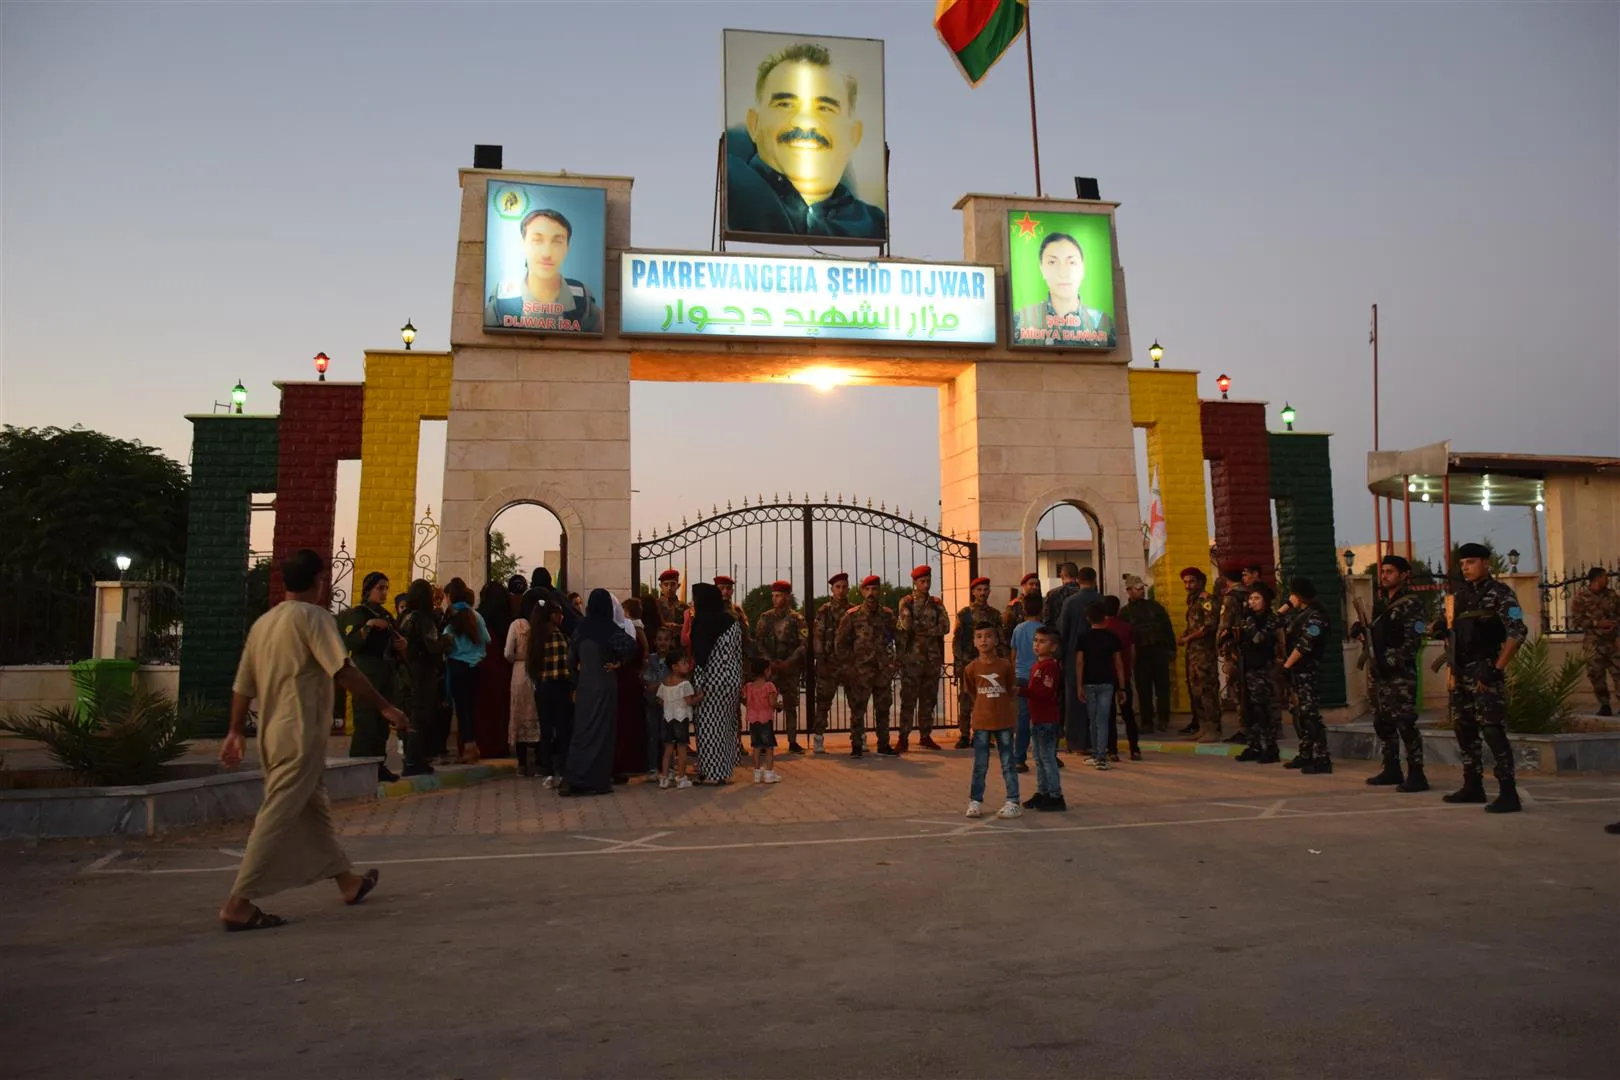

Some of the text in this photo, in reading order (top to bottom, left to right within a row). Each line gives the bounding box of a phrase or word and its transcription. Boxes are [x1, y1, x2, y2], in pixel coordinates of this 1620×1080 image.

[631, 259, 818, 293] PAKREWANGEHA
[901, 269, 985, 300] DIJWAR
[660, 299, 960, 337] مزار الشهيد دجوار
